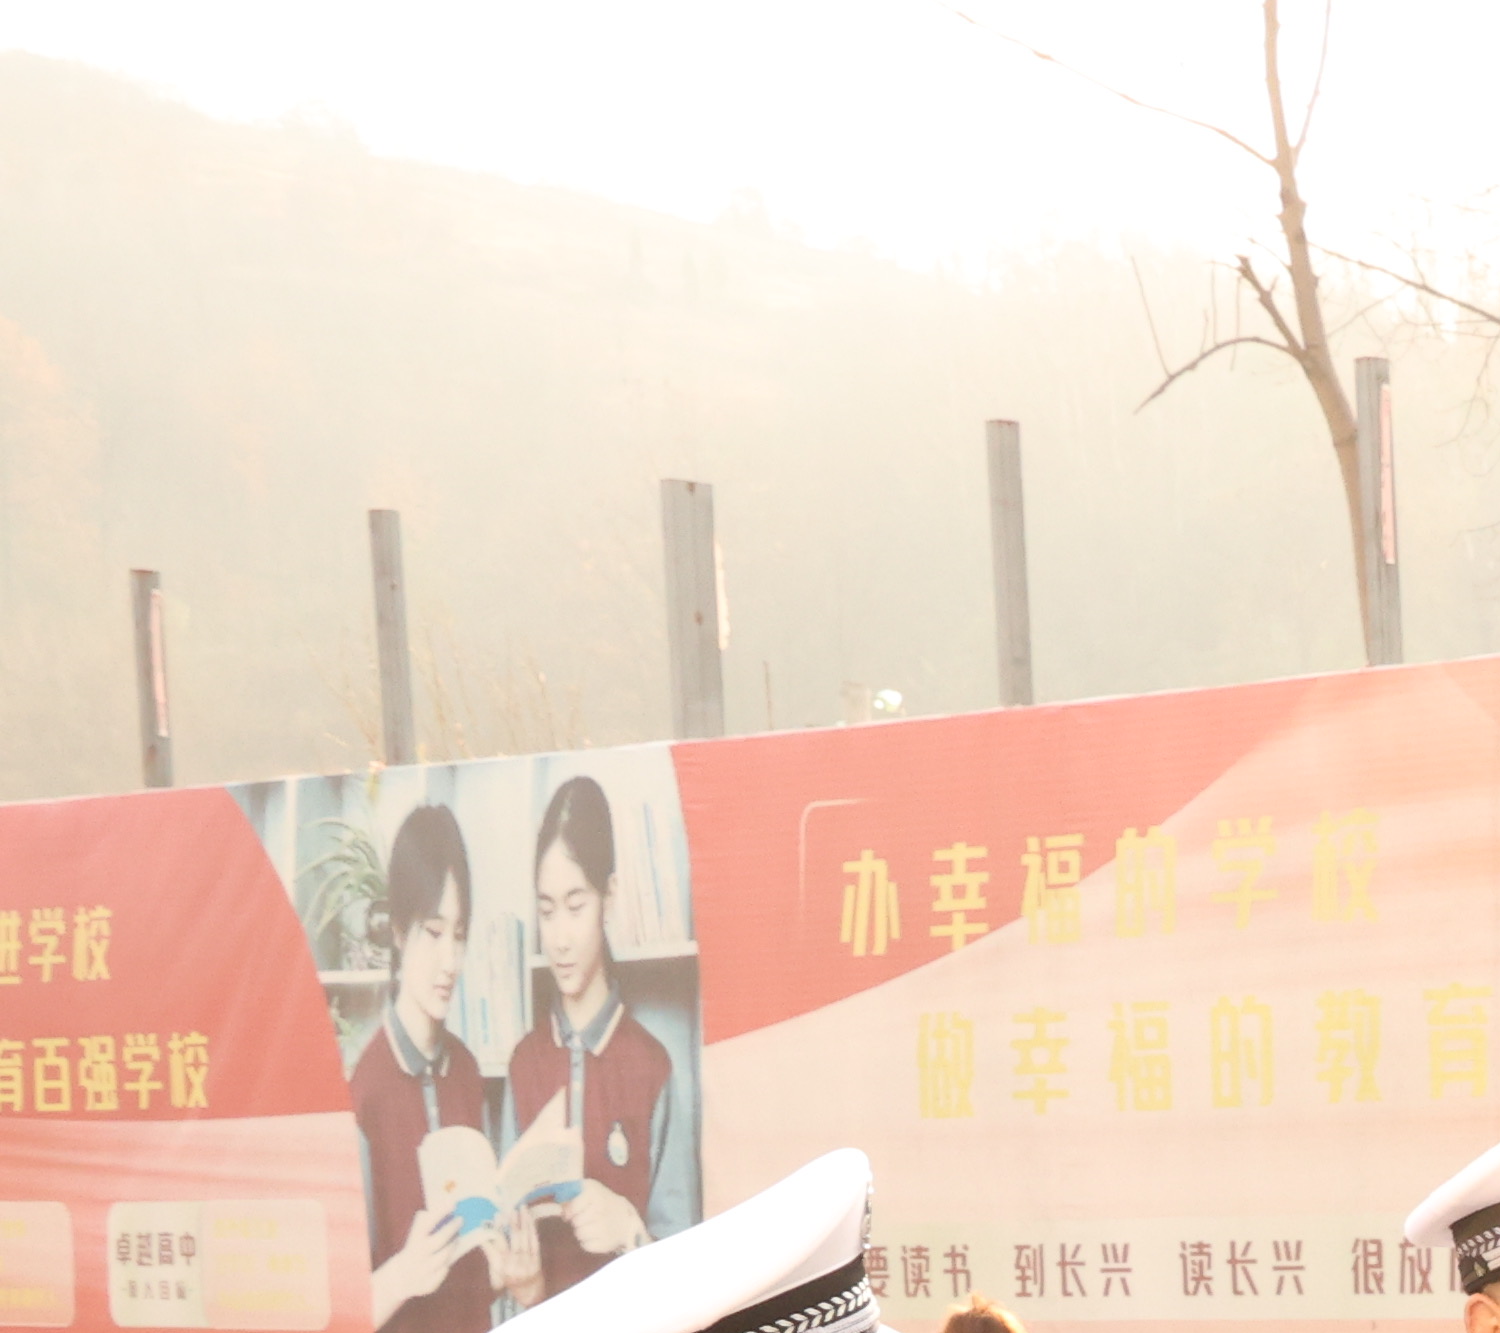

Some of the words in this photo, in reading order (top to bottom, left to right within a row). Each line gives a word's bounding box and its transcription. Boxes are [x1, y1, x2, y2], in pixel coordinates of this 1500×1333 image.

[839, 808, 1382, 957] 办幸福的学校
[916, 983, 1494, 1120] 做幸福的教育
[1013, 1243, 1133, 1298] 到长兴
[1179, 1239, 1306, 1296] 读长兴
